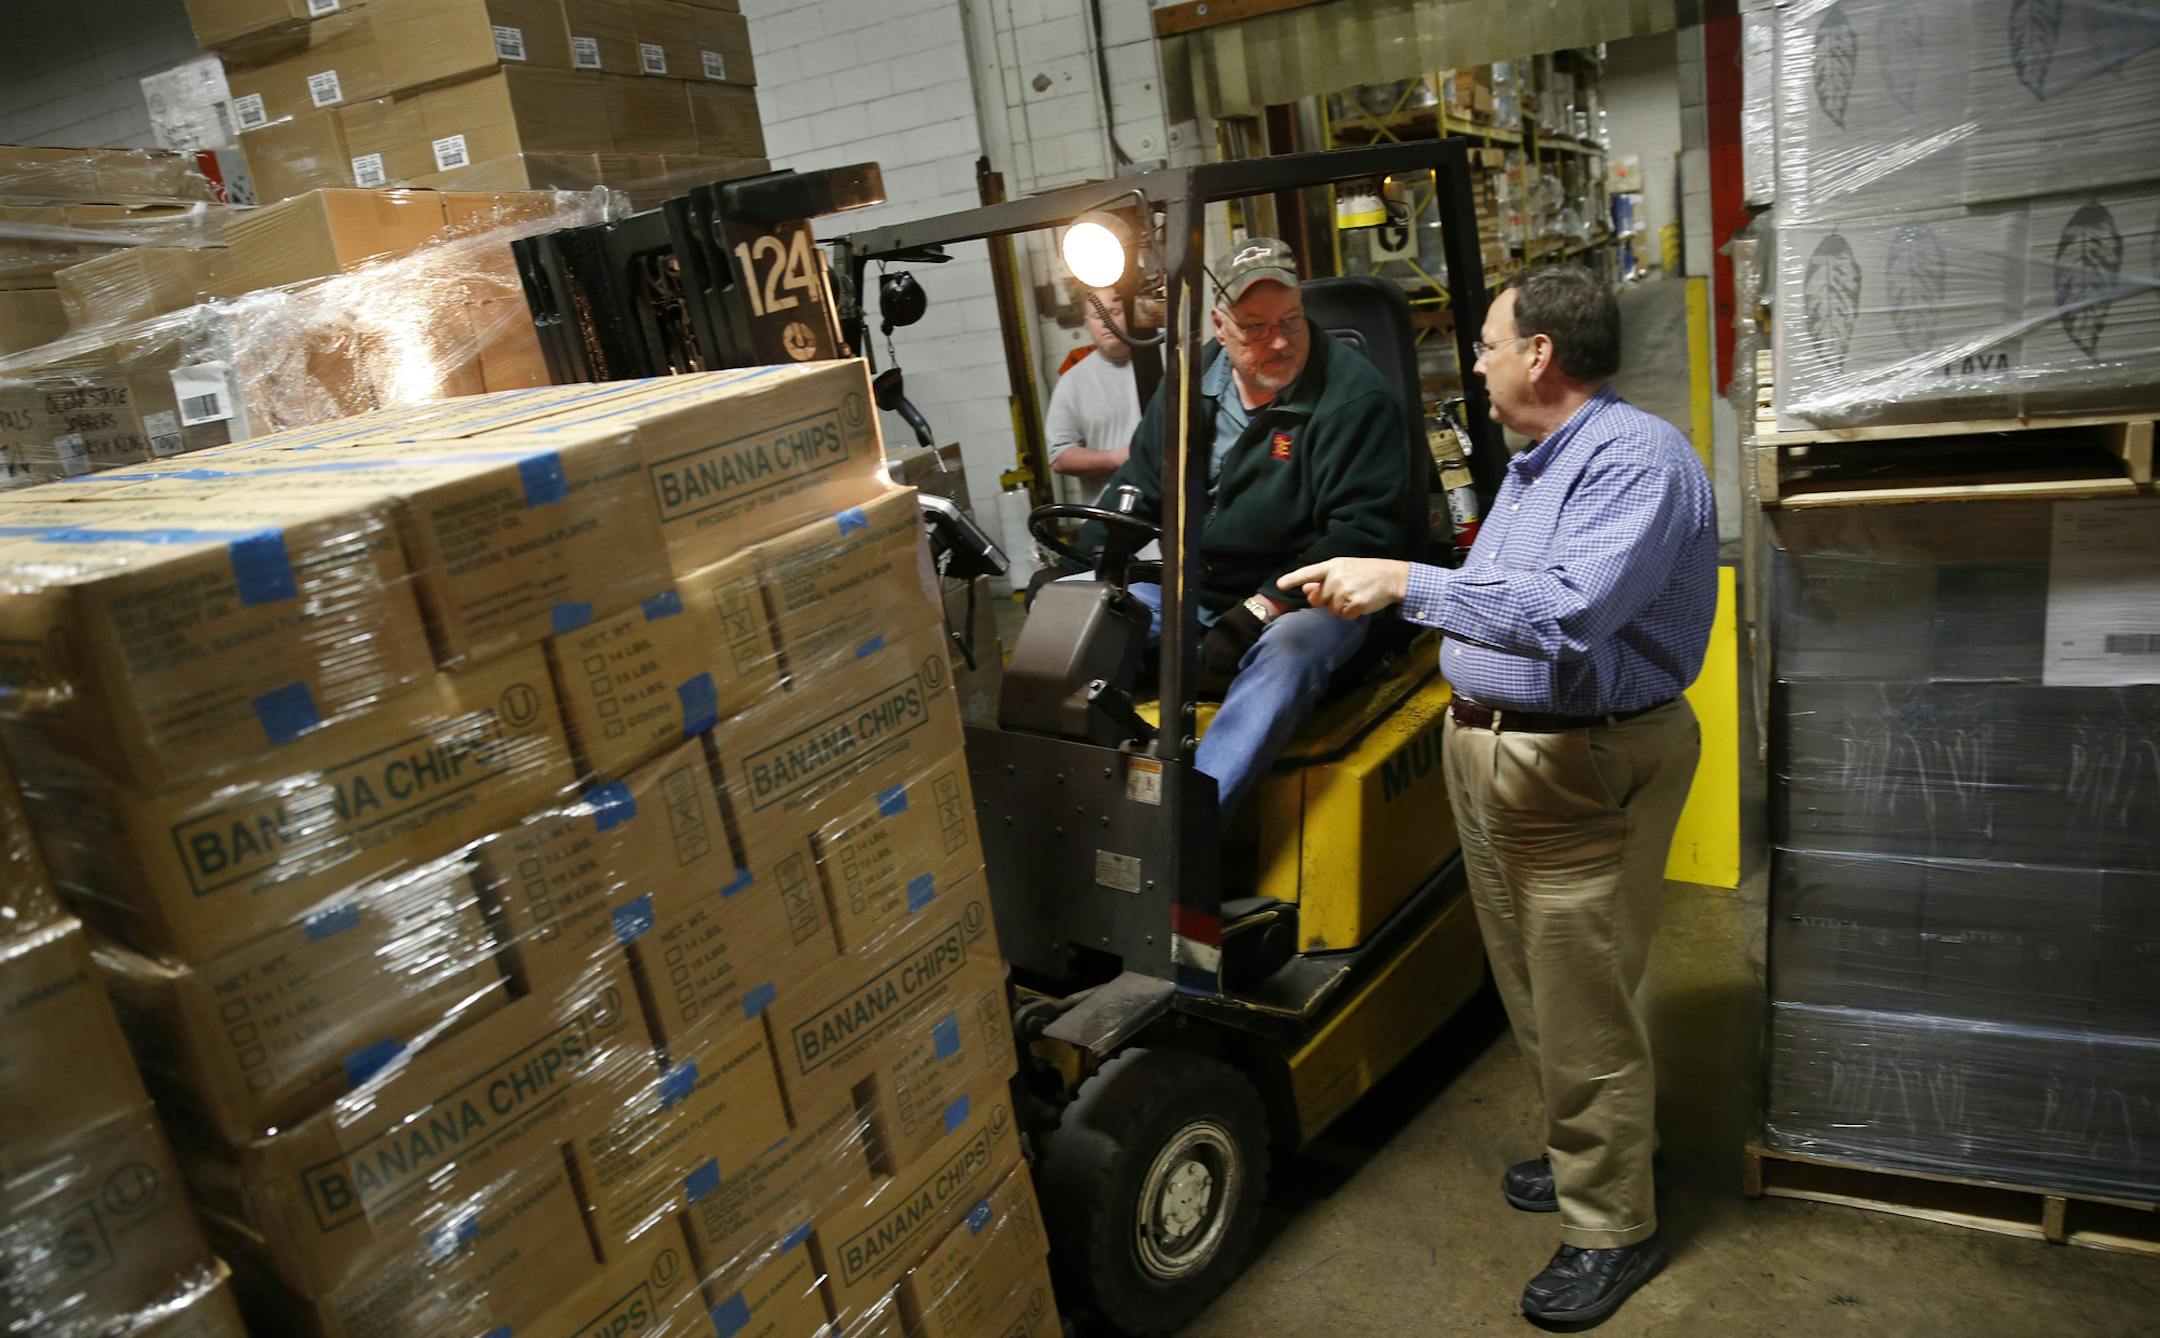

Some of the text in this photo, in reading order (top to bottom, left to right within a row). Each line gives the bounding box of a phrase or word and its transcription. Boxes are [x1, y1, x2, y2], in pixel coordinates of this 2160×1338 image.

[734, 229, 819, 317] 124
[659, 421, 842, 509] BANANA CHIPS
[750, 724, 857, 798] BANANA
[856, 688, 921, 741] CHIPS
[189, 775, 382, 878] BANNA
[801, 936, 962, 1063] BANANA CHIPS
[319, 1098, 486, 1215] BANANA
[487, 1032, 585, 1116] CHIPS
[846, 1139, 987, 1275] BANANA CHIPS
